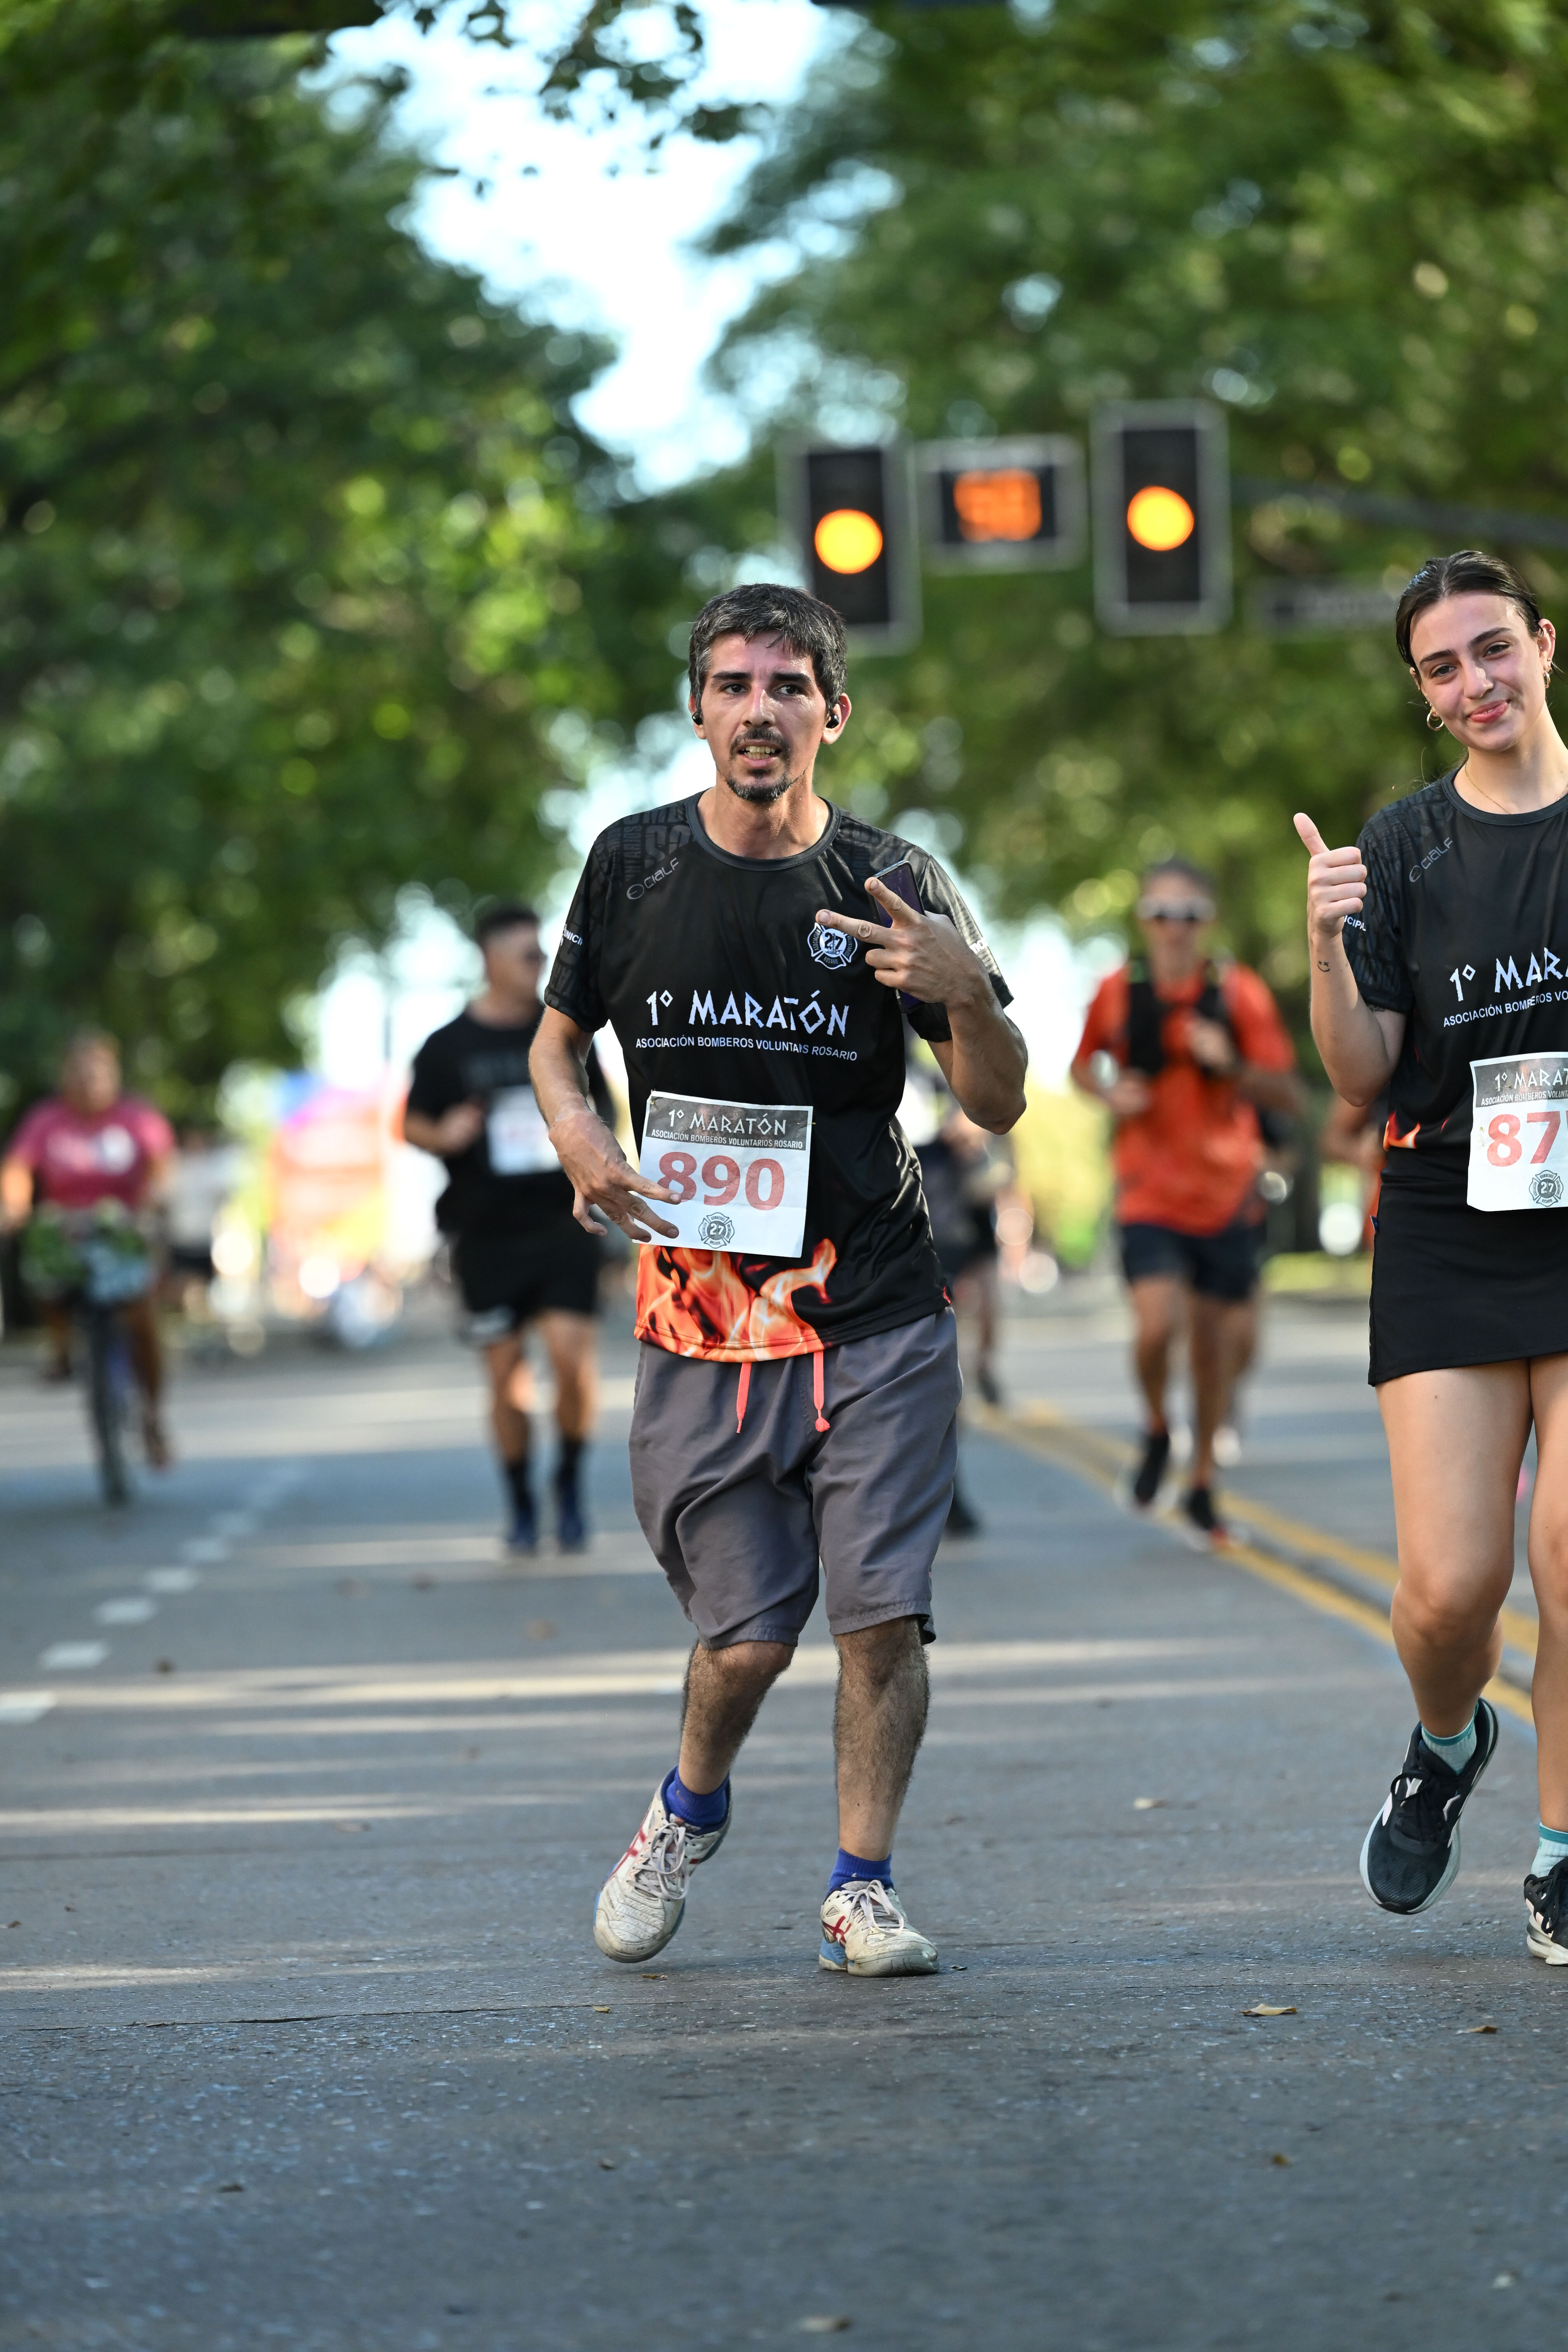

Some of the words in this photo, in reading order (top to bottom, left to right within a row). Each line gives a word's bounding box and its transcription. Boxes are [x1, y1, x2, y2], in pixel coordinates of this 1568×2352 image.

[824, 932, 843, 950] 27
[1494, 947, 1568, 993] MAR
[688, 990, 849, 1037] MARATÓN
[1444, 1004, 1502, 1027] ASOCIACIÓN
[636, 1035, 694, 1048] ASOCIACIÓN
[698, 1037, 753, 1048] BOMBEROS
[812, 1046, 857, 1061] ROSARIO
[1481, 1093, 1513, 1106] ASOCIACIÓN
[1515, 1091, 1547, 1101] BOMBEROS
[690, 1112, 786, 1135] MARATÓN
[651, 1129, 689, 1141] ASOCIACIÓN
[691, 1134, 726, 1144] BOMBEROS
[729, 1138, 772, 1147] VOLUNTARIOS
[774, 1140, 803, 1149] ROSARIO
[1487, 1110, 1568, 1167] 87
[658, 1152, 785, 1210] 890
[1540, 1181, 1554, 1194] 27
[710, 1223, 724, 1235] 27
